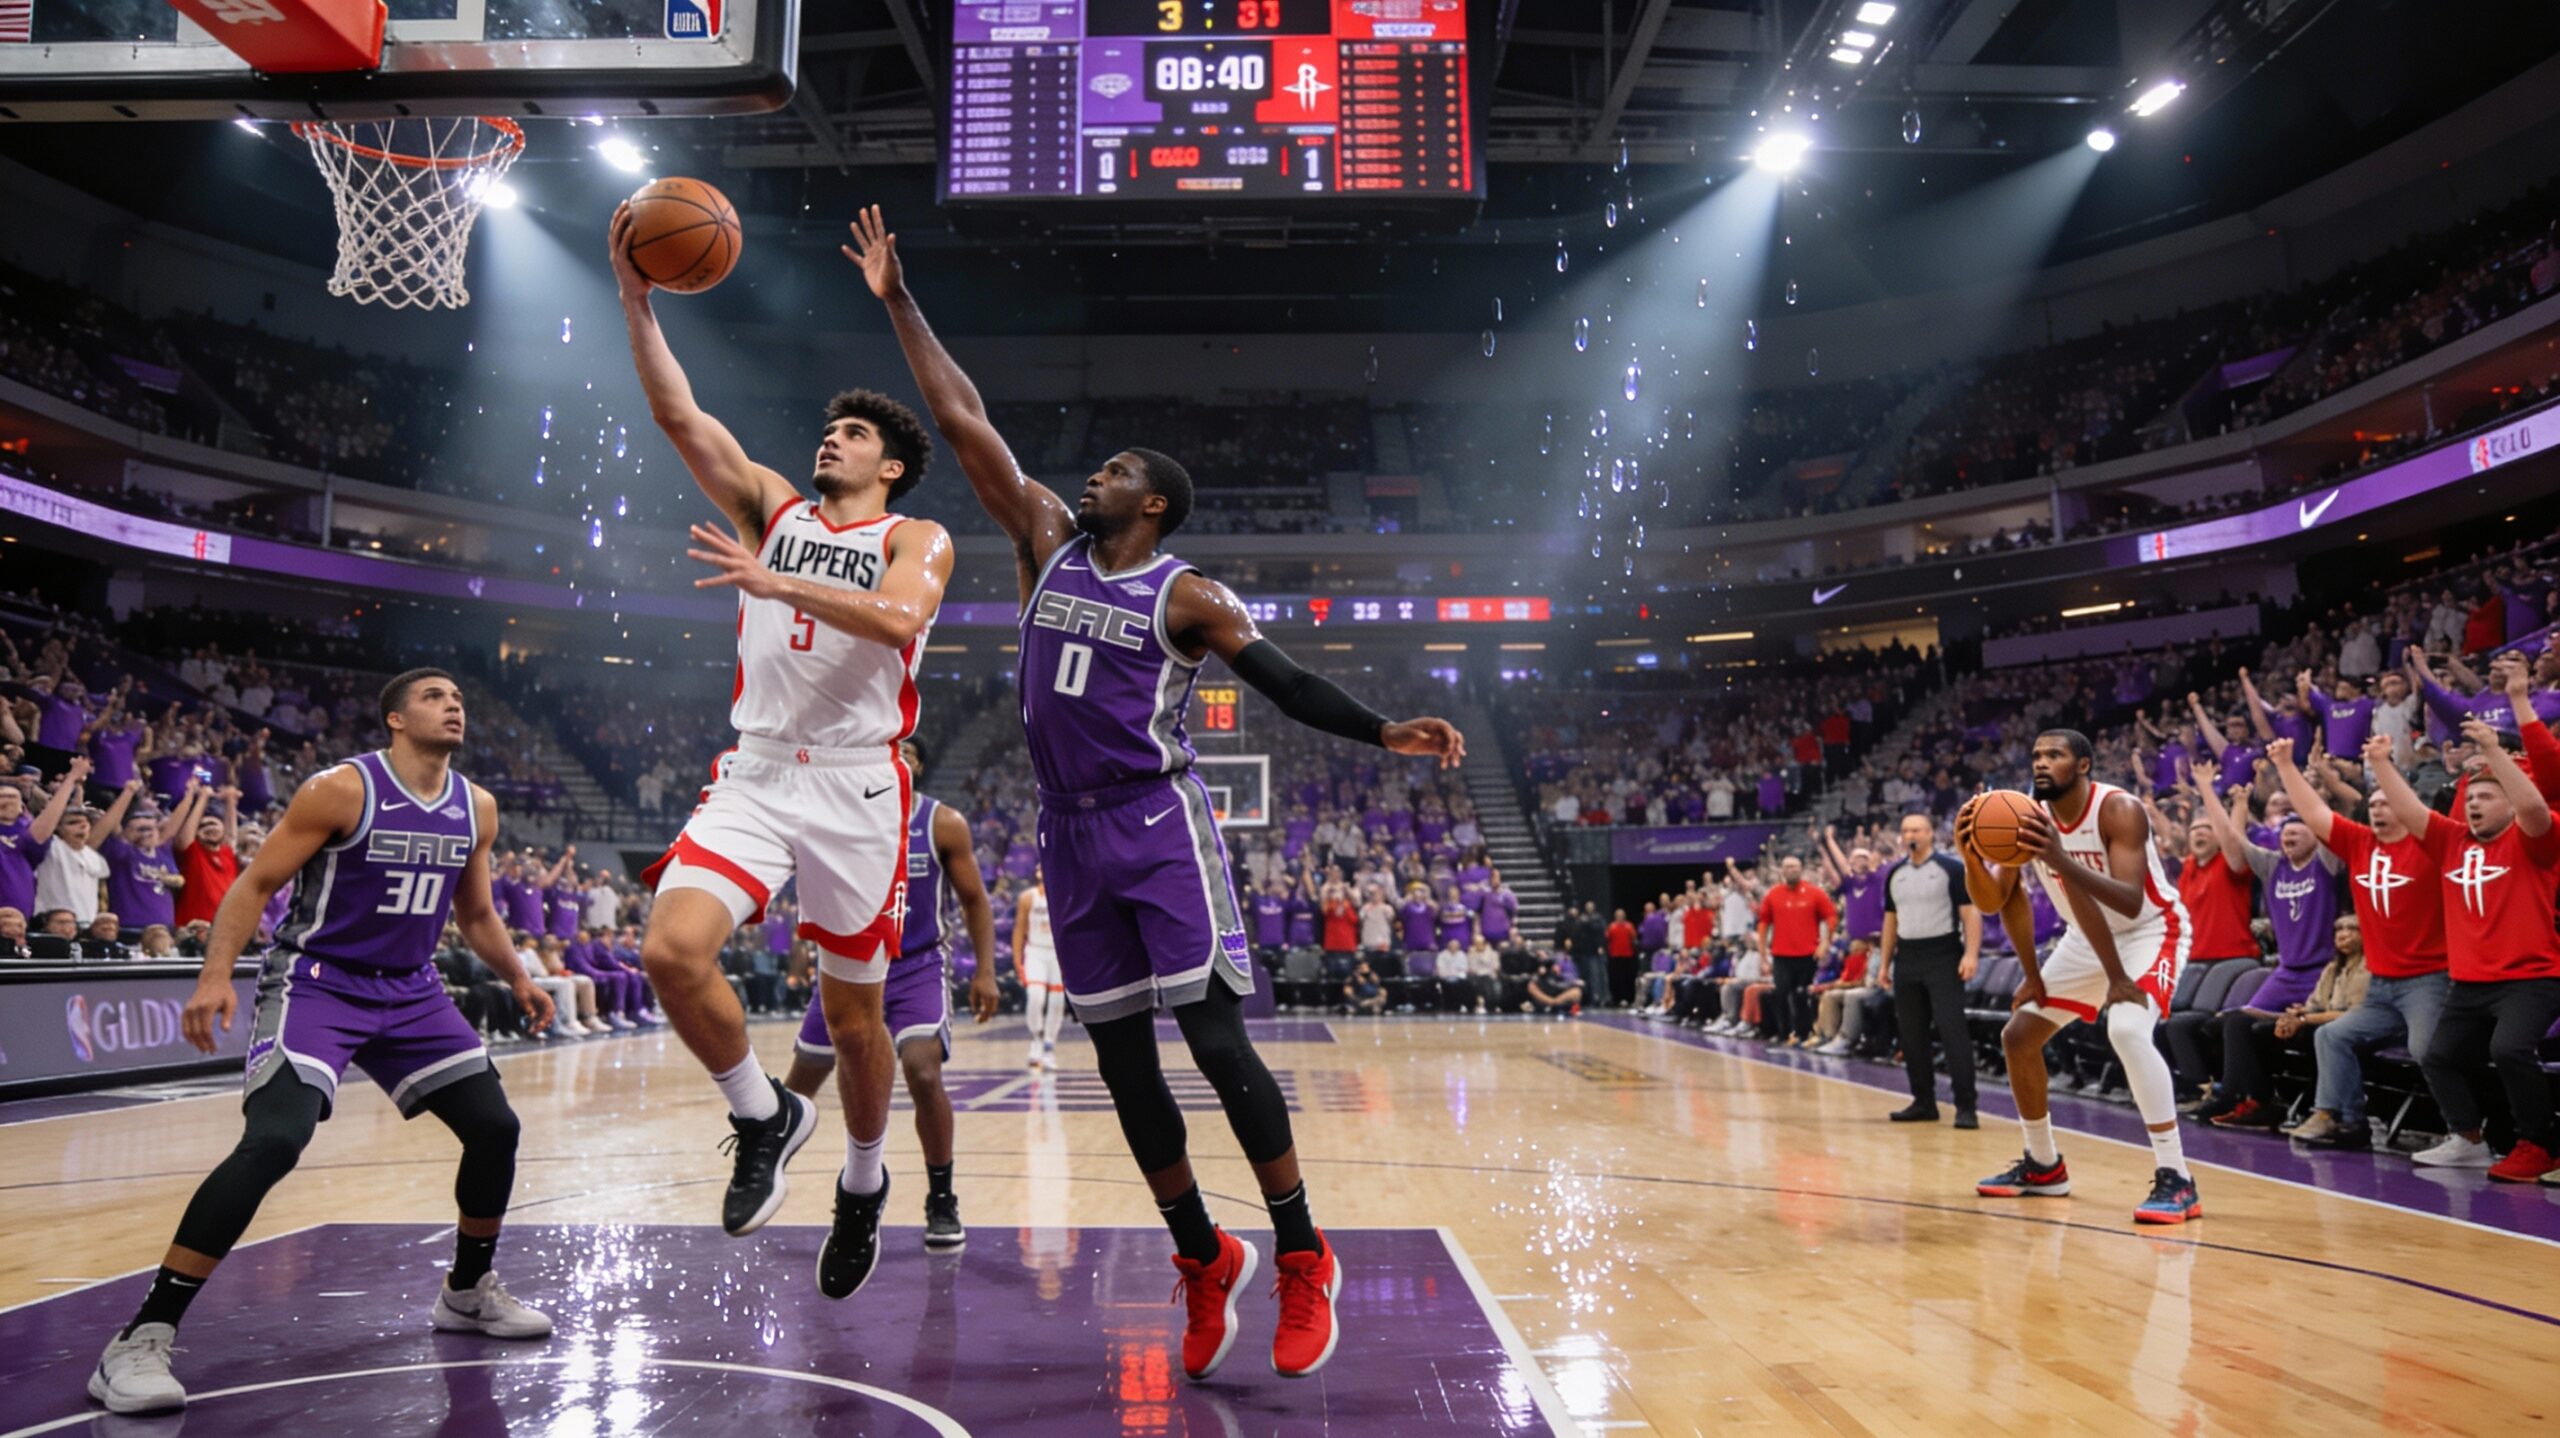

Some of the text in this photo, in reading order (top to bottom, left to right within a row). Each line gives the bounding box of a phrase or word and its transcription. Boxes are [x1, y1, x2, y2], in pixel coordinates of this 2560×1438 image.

[768, 535, 877, 590] ALPPERS
[790, 608, 815, 652] 5
[1033, 589, 1151, 652] SAC
[1054, 641, 1093, 697] 0
[366, 829, 470, 867] SAC
[376, 870, 445, 915] 30
